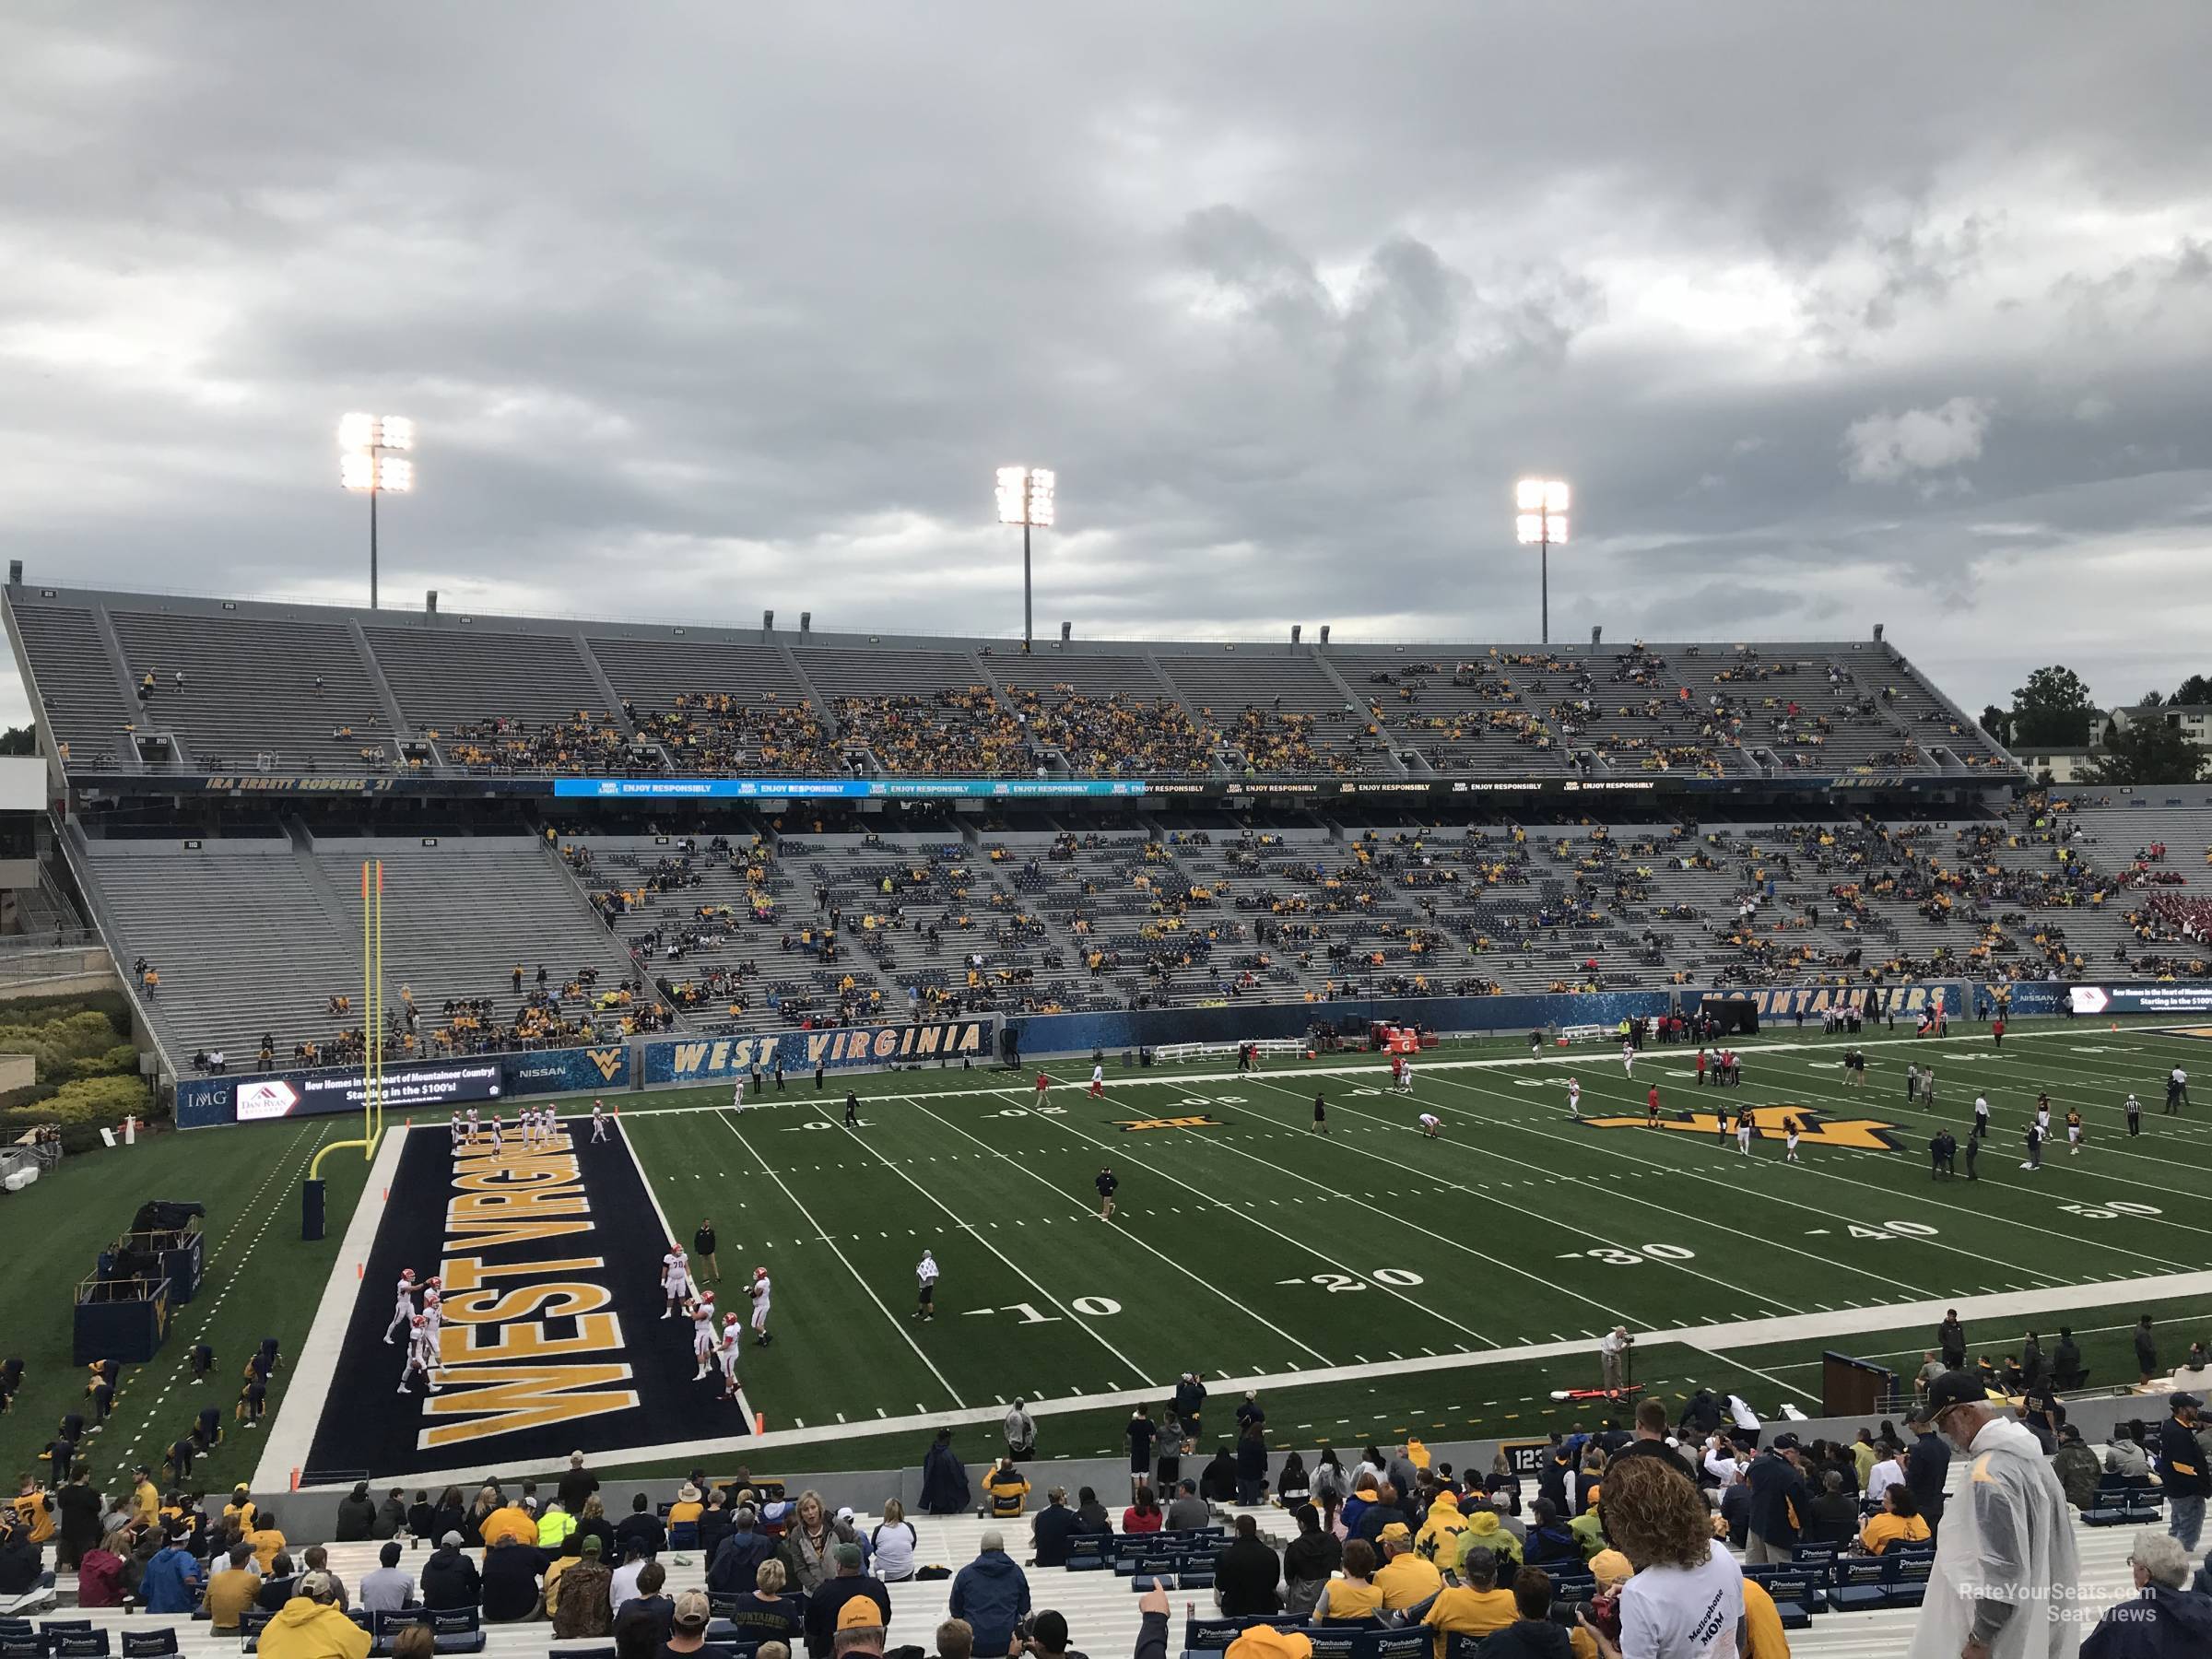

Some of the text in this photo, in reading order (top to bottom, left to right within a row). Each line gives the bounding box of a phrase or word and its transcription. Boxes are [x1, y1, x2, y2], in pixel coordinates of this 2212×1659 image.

[206, 778, 231, 789] IRA
[298, 779, 366, 790] RODGERS
[374, 779, 393, 791] 21
[623, 784, 712, 793] ENJOY RESPONSIBLY
[1132, 784, 1153, 793] ENJOY
[674, 1023, 980, 1073] WEST VIRGINIA
[1402, 1041, 1409, 1051] G
[305, 1081, 324, 1090] New
[324, 1079, 352, 1089] Homes
[353, 1078, 361, 1088] in
[363, 1077, 377, 1087] te
[402, 1074, 411, 1083] of
[412, 1070, 462, 1082] Mountaineer
[462, 1066, 495, 1079] Country!
[519, 1067, 566, 1078] NISSAN
[187, 1090, 227, 1107] IMG
[391, 1087, 400, 1097] in
[402, 1085, 419, 1095] the
[421, 1082, 456, 1094] $100's!
[2056, 1200, 2164, 1220] 50
[1843, 1219, 1940, 1241] 40
[1585, 1242, 1696, 1266] 30
[417, 1123, 641, 1451] WEST VIRGINIA
[1311, 1267, 1425, 1293] 20
[1000, 1296, 1123, 1324] 10
[1514, 1449, 1544, 1470] 123
[1777, 1581, 1806, 1589] Panhandle
[1688, 1588, 1724, 1642] Mellophone
[1206, 1629, 1239, 1637] Panhandle
[1700, 1611, 1724, 1647] MOM
[1315, 1640, 1353, 1648] Panhandle
[1387, 1637, 1423, 1648] Panhandle
